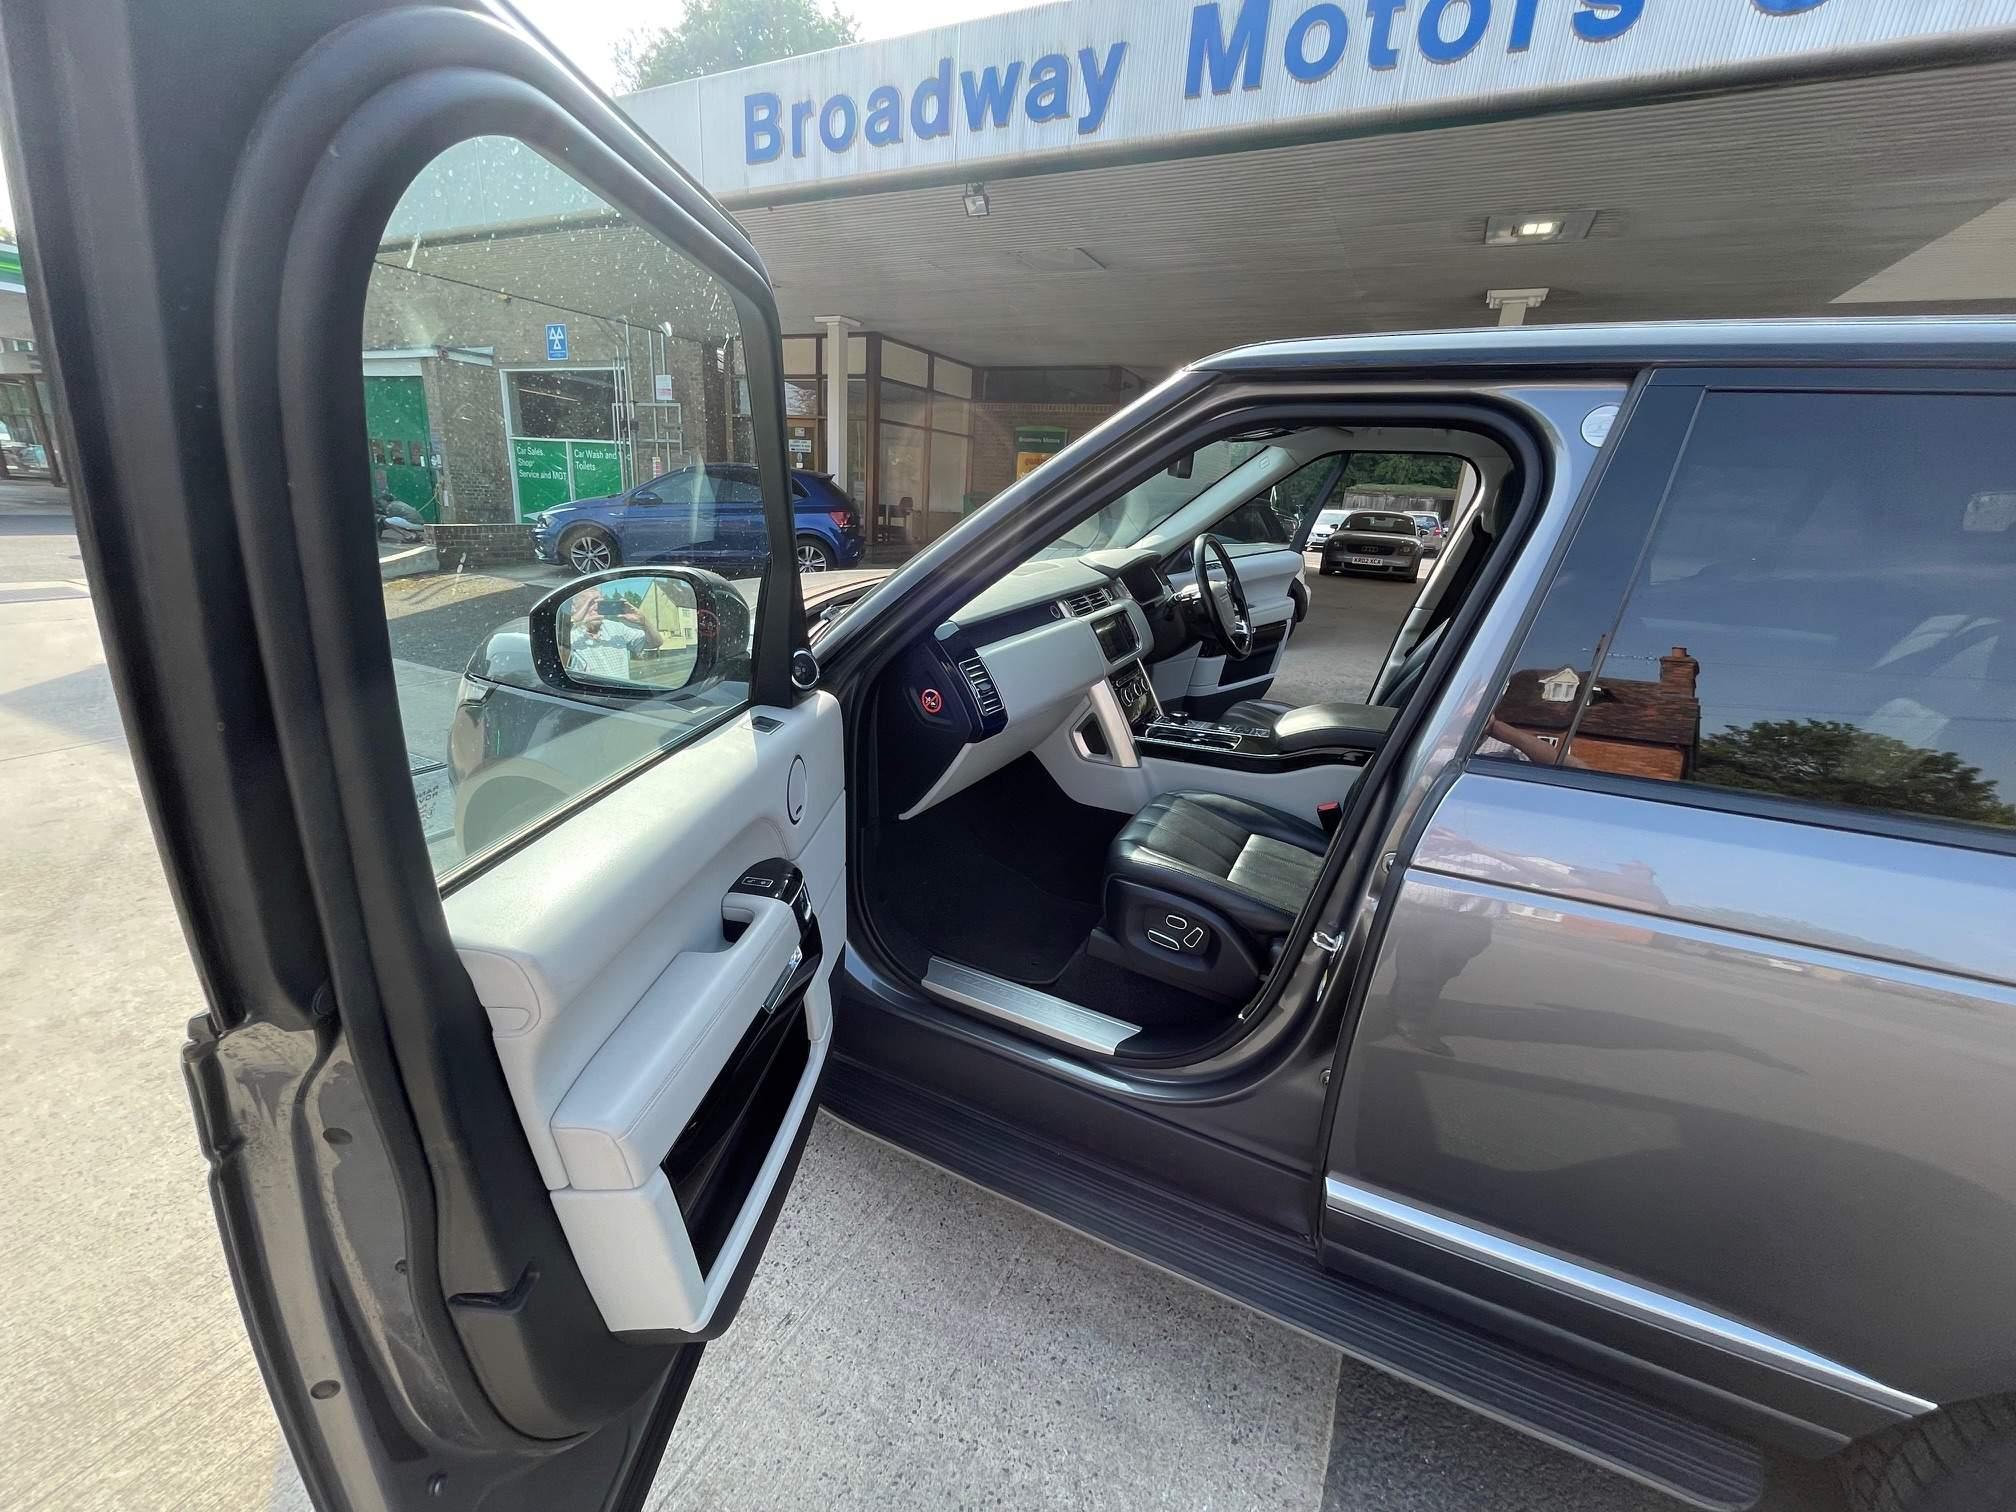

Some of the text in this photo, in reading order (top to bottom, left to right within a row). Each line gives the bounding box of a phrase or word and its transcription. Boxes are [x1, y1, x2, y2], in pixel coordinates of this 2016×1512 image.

[744, 41, 1129, 165] Broadway
[516, 446, 527, 455] Car
[574, 449, 618, 460] Car Wash and
[518, 457, 534, 468] Shop
[575, 460, 596, 471] Toilets
[519, 469, 540, 478] Service
[540, 471, 552, 479] and
